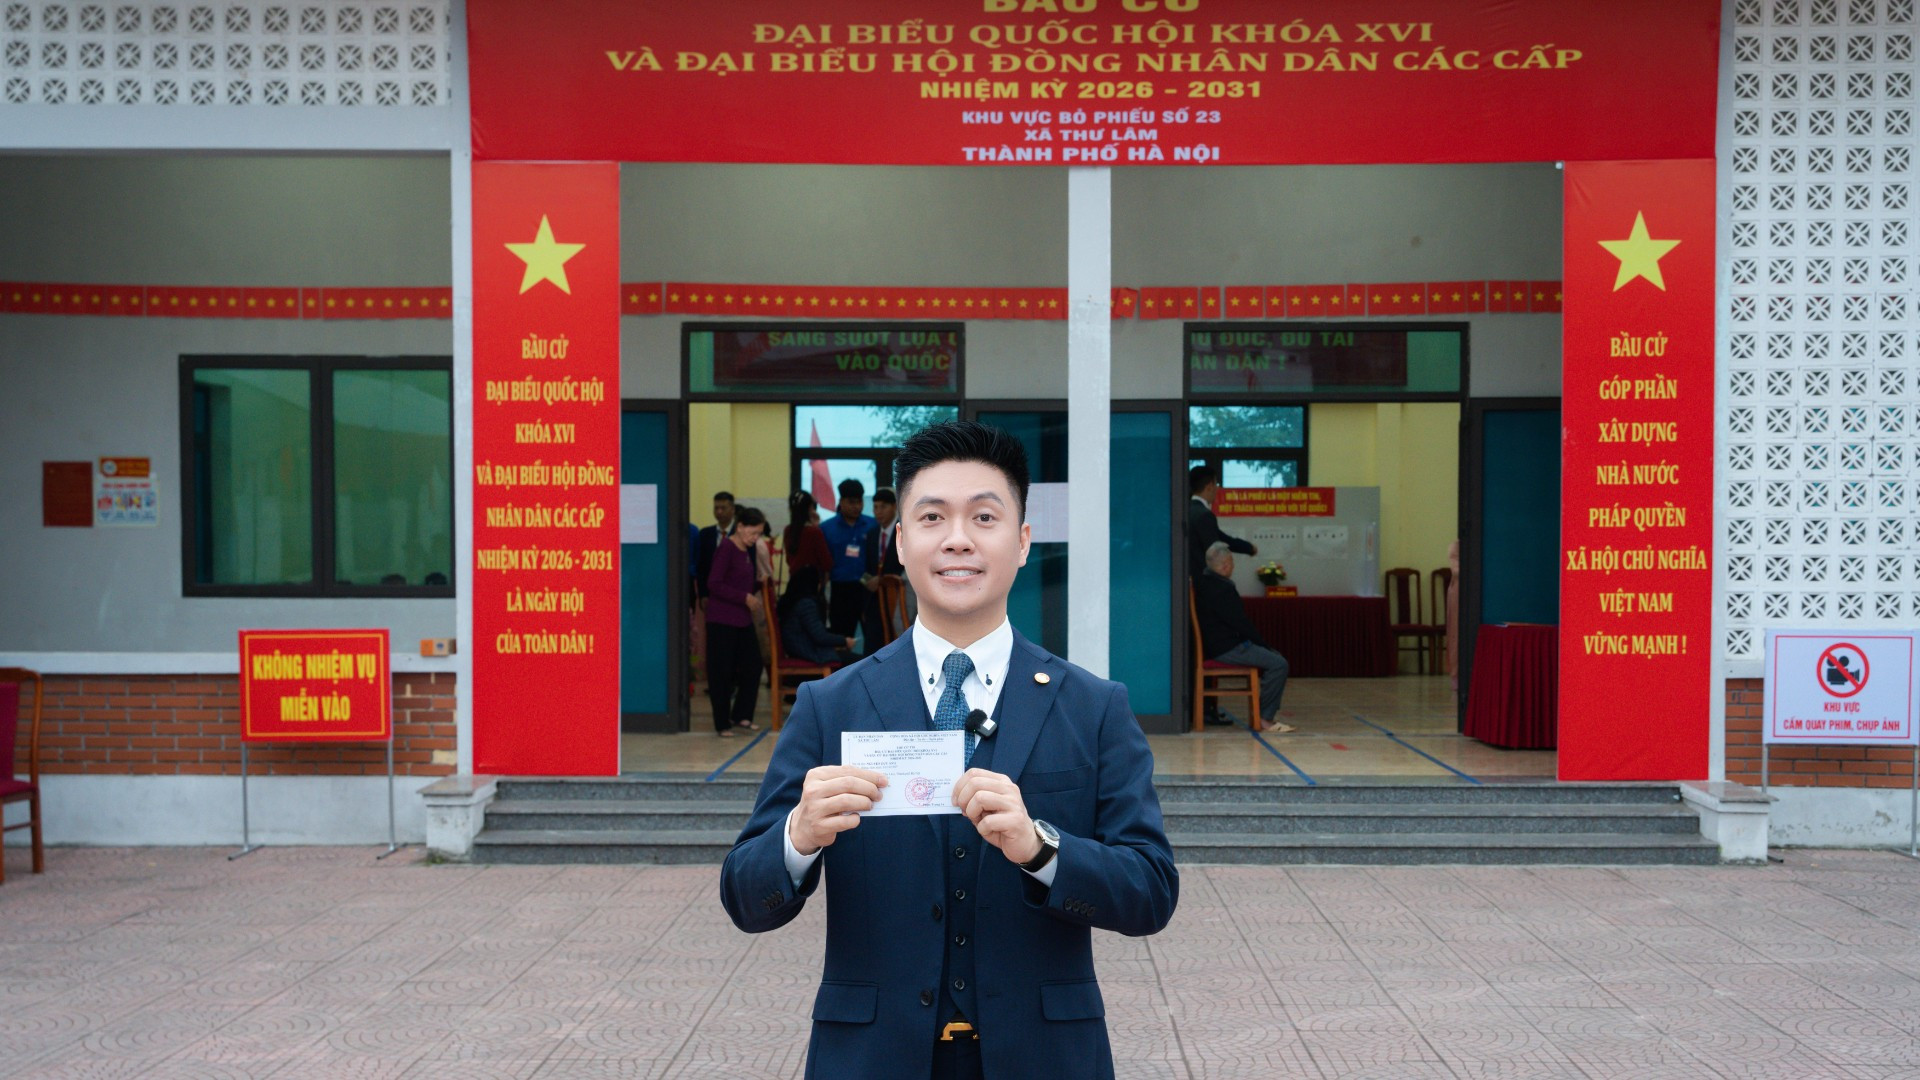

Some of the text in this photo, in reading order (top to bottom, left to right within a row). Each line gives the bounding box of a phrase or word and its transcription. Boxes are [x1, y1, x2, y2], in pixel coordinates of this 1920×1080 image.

[753, 19, 1433, 48] ĐẠI BIỂU QUỐC HỘI KHÓA XVI
[605, 44, 1582, 77] VÀ ĐẠI BIỂU HỘI ĐỒNG NHÂN DÂN CÁC CẤP
[921, 78, 1018, 102] NHIỆM
[1031, 79, 1067, 98] KỲ
[1078, 82, 1153, 98] 2026
[1188, 81, 1260, 97] 2031
[962, 107, 1221, 126] KHU VỰC BỎ PHIẾU SỐ 23
[1025, 127, 1157, 141] XÃ THƯ LÂM
[962, 143, 1219, 163] THÀNH PHỐ HÀ NỘI
[522, 333, 569, 359] BẦU CỬ
[1611, 331, 1668, 357] BẦU CỬ
[486, 381, 508, 405] ĐẠI
[543, 376, 578, 406] QUỐC
[581, 377, 604, 406] HỘI
[1599, 374, 1677, 399] GÓP PHẦN
[516, 419, 575, 443] KHÓA XVI
[1599, 418, 1677, 446] XÂY DỰNG
[476, 460, 493, 485] VÀ
[495, 465, 517, 490] ĐẠI
[552, 461, 575, 490] HỘI
[578, 460, 614, 485] ĐỒNG
[1597, 460, 1679, 485] NHÀ NƯỚC
[487, 502, 604, 528] NHÂN DÂN CÁC CẤP
[1589, 502, 1686, 531] PHÁP QUYỀN
[478, 545, 519, 574] NHIỆM
[522, 545, 539, 569] KỲ
[541, 550, 573, 570] 2026
[582, 550, 612, 570] 2031
[1567, 545, 1707, 575] XÃ HỘI CHỦ NGHĨA
[507, 587, 584, 616] LÀ NGÀY HỘI
[1600, 588, 1673, 617] VIỆT NAM
[496, 629, 521, 653] CỦA
[523, 629, 557, 653] TOÀN
[560, 629, 586, 654] DÂN
[1584, 631, 1628, 654] VỮNG
[1632, 635, 1678, 659] MẠNH
[253, 649, 376, 684] KHÔNG NHIỆM VỤ
[321, 691, 350, 720] VÀO
[1824, 702, 1860, 714] KHU VỰC
[1784, 716, 1900, 732] CẤM QUAY PHIM, CHỤP ẢNH
